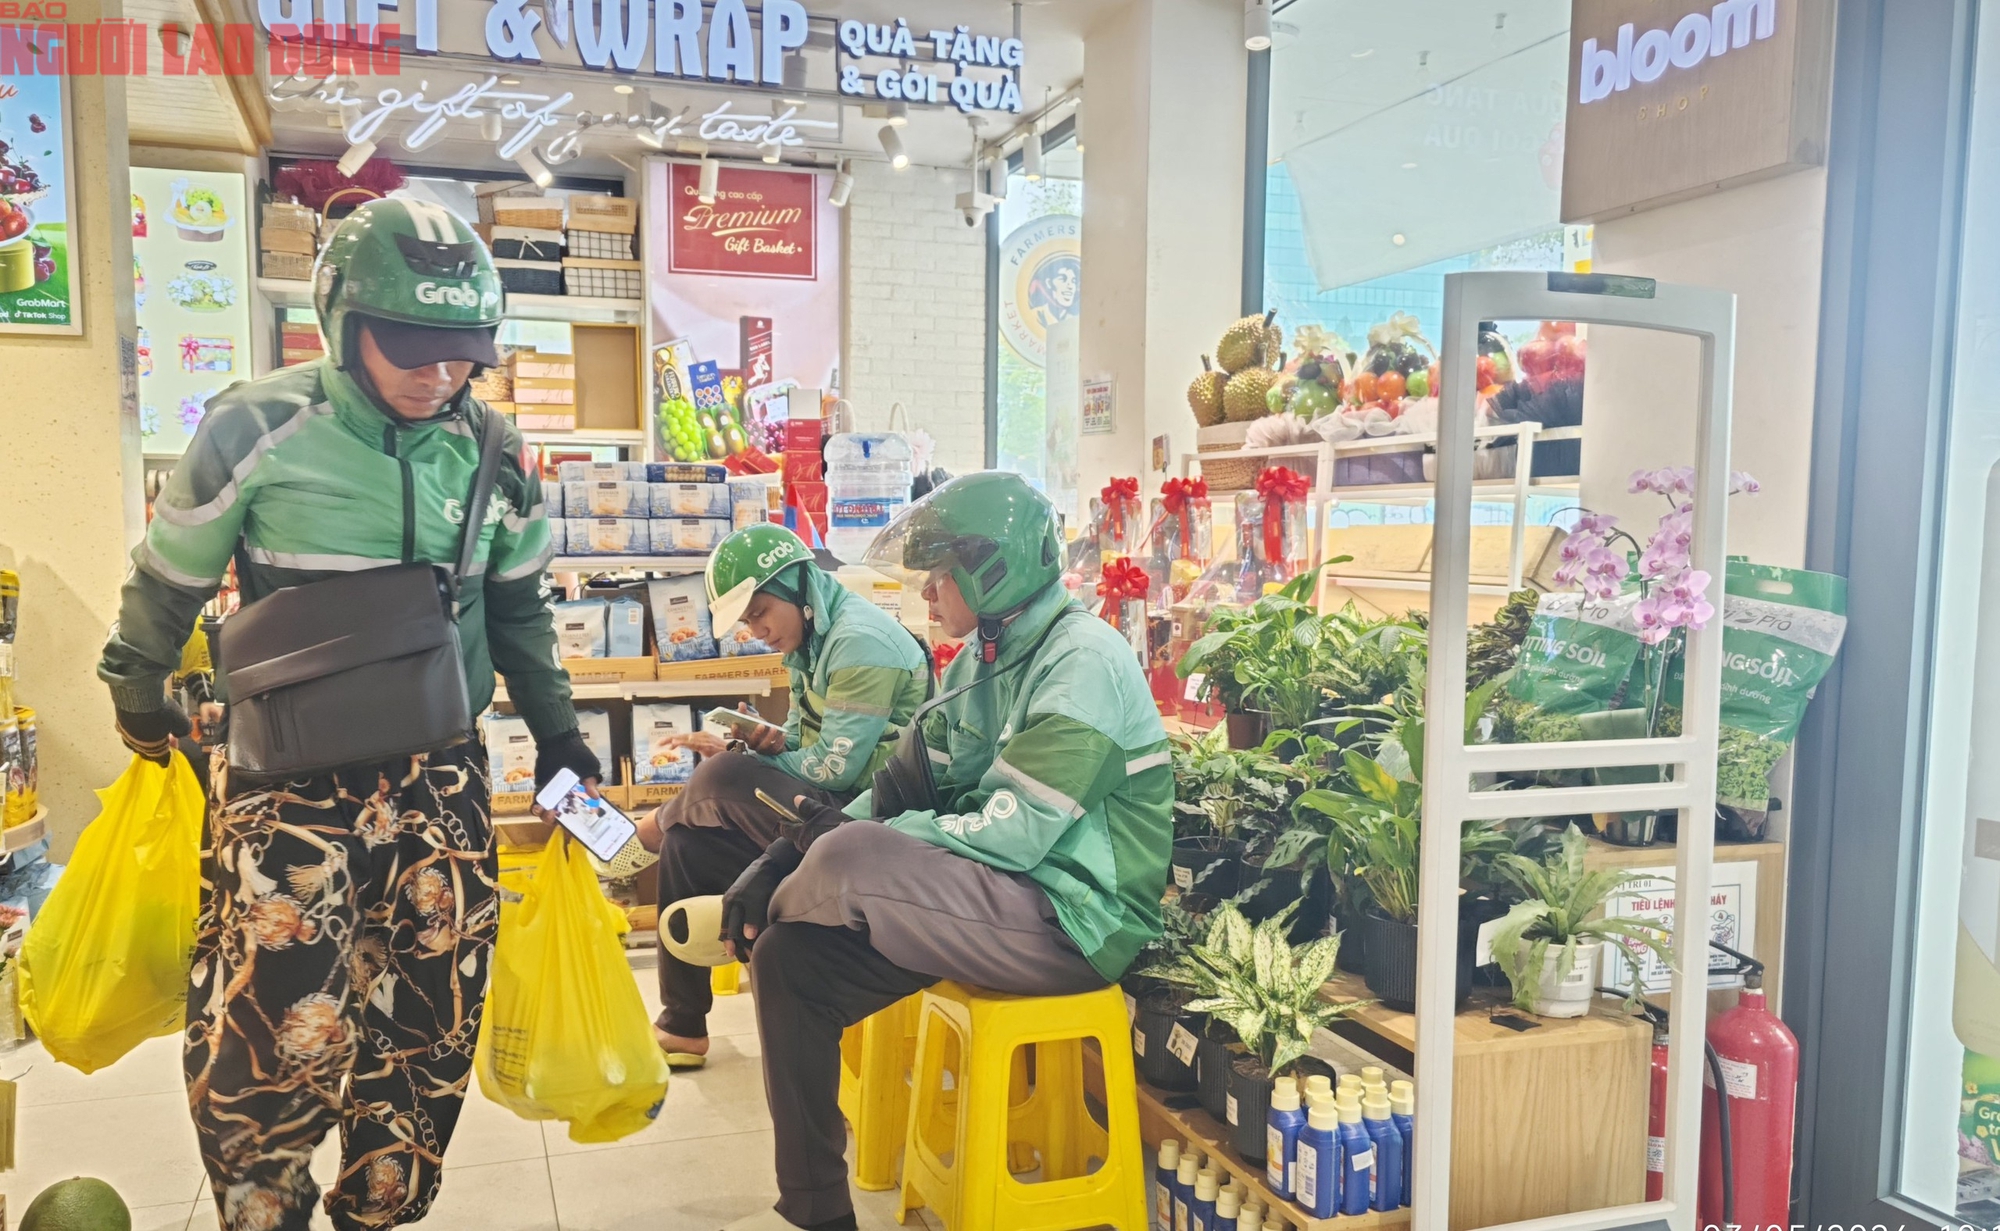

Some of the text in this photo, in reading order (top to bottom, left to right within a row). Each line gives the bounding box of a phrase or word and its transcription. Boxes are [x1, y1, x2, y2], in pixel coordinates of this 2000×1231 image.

[485, 0, 541, 62] &
[572, 0, 808, 85] WRAP
[840, 17, 1024, 69] QUÀ TẶNG
[1579, 0, 1776, 104] bloom
[841, 65, 1023, 113] & GÓI QUÀ
[1637, 85, 1710, 120] SHOP
[728, 191, 744, 199] cao
[746, 190, 763, 202] cấp
[683, 204, 802, 231] Premium
[724, 236, 796, 255] Gift Basket
[1010, 224, 1077, 267] FARMERS
[16, 298, 66, 308] GrabMart
[415, 281, 480, 308] Grab
[23, 311, 66, 321] TikTok Shop
[757, 540, 795, 569] Grab
[1521, 635, 1607, 669] OTTING SOIL
[753, 666, 788, 678] MARK
[497, 794, 532, 806] FARM
[646, 786, 680, 797] FARM
